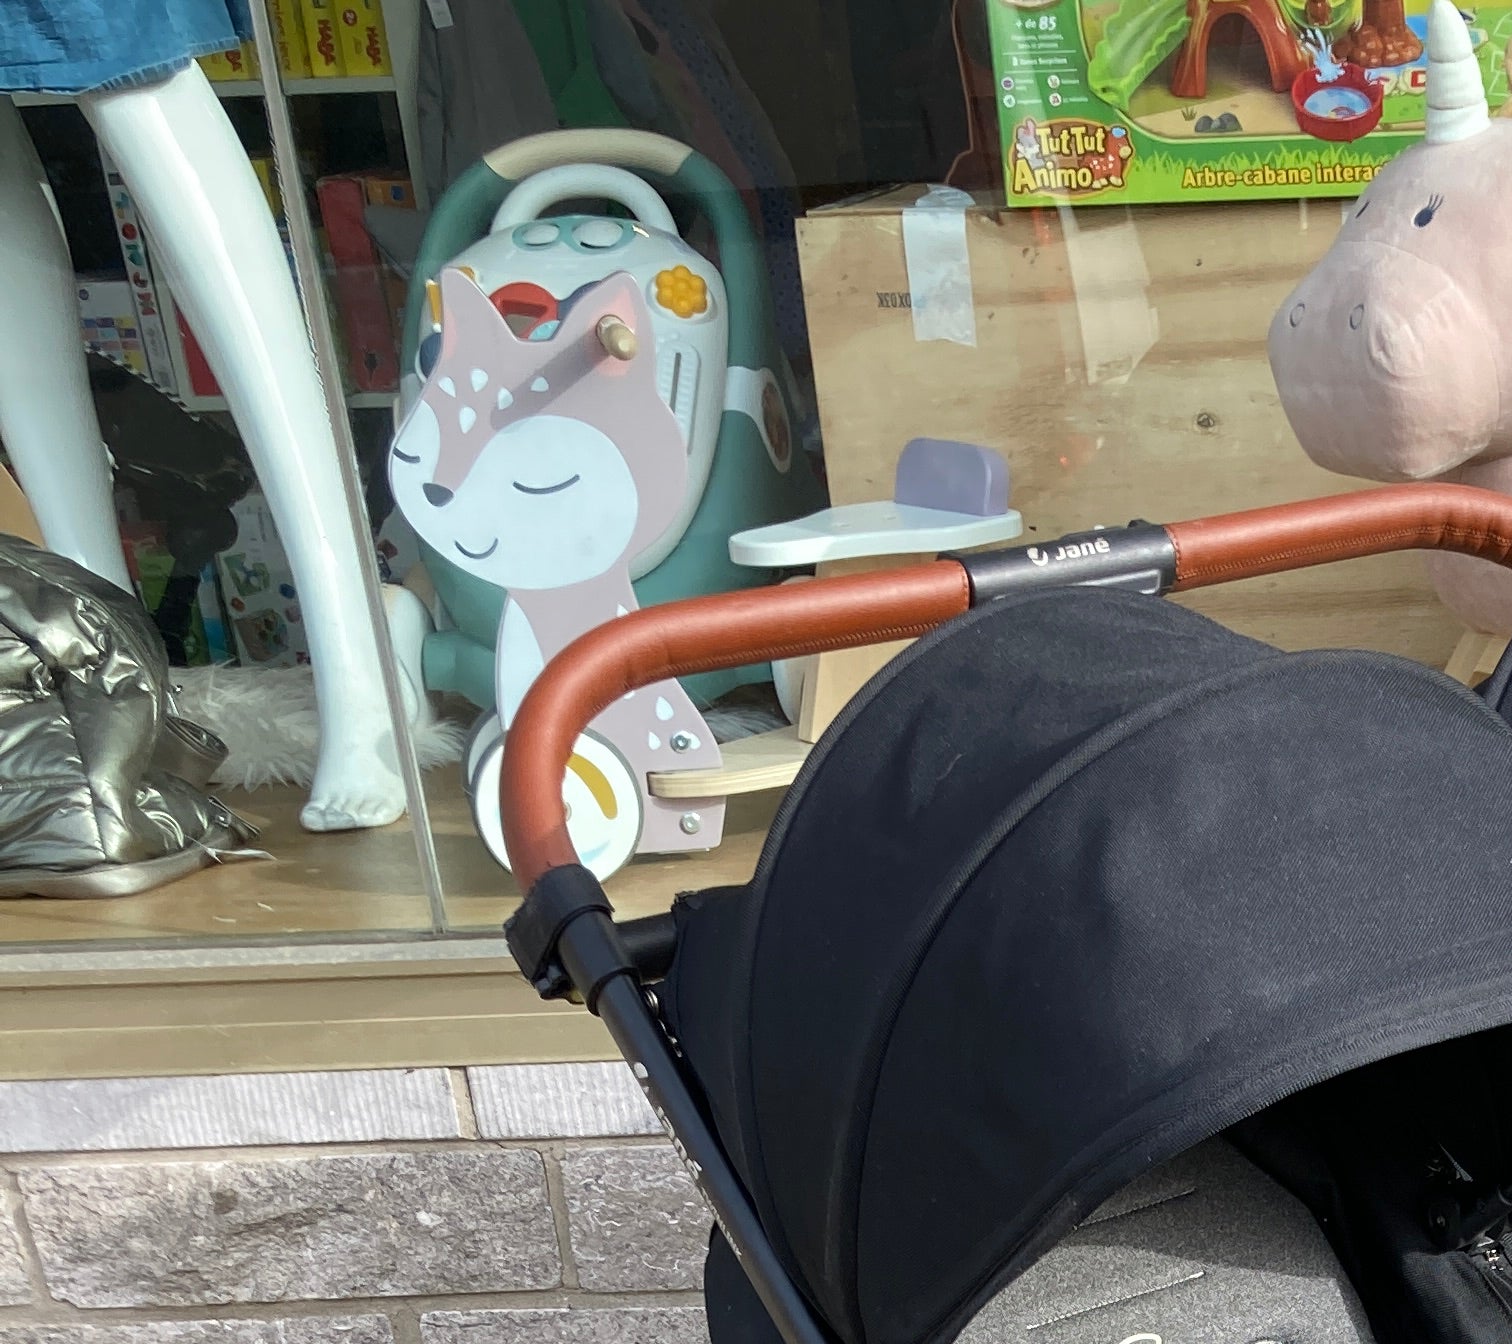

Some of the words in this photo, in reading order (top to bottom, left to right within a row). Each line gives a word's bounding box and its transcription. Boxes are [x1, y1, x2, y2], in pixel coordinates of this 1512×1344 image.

[1039, 16, 1057, 31] 85
[1035, 126, 1071, 156] Tut
[1071, 126, 1105, 155] Tut
[1013, 158, 1093, 193] Animo
[1182, 164, 1311, 188] Arbre-cabane
